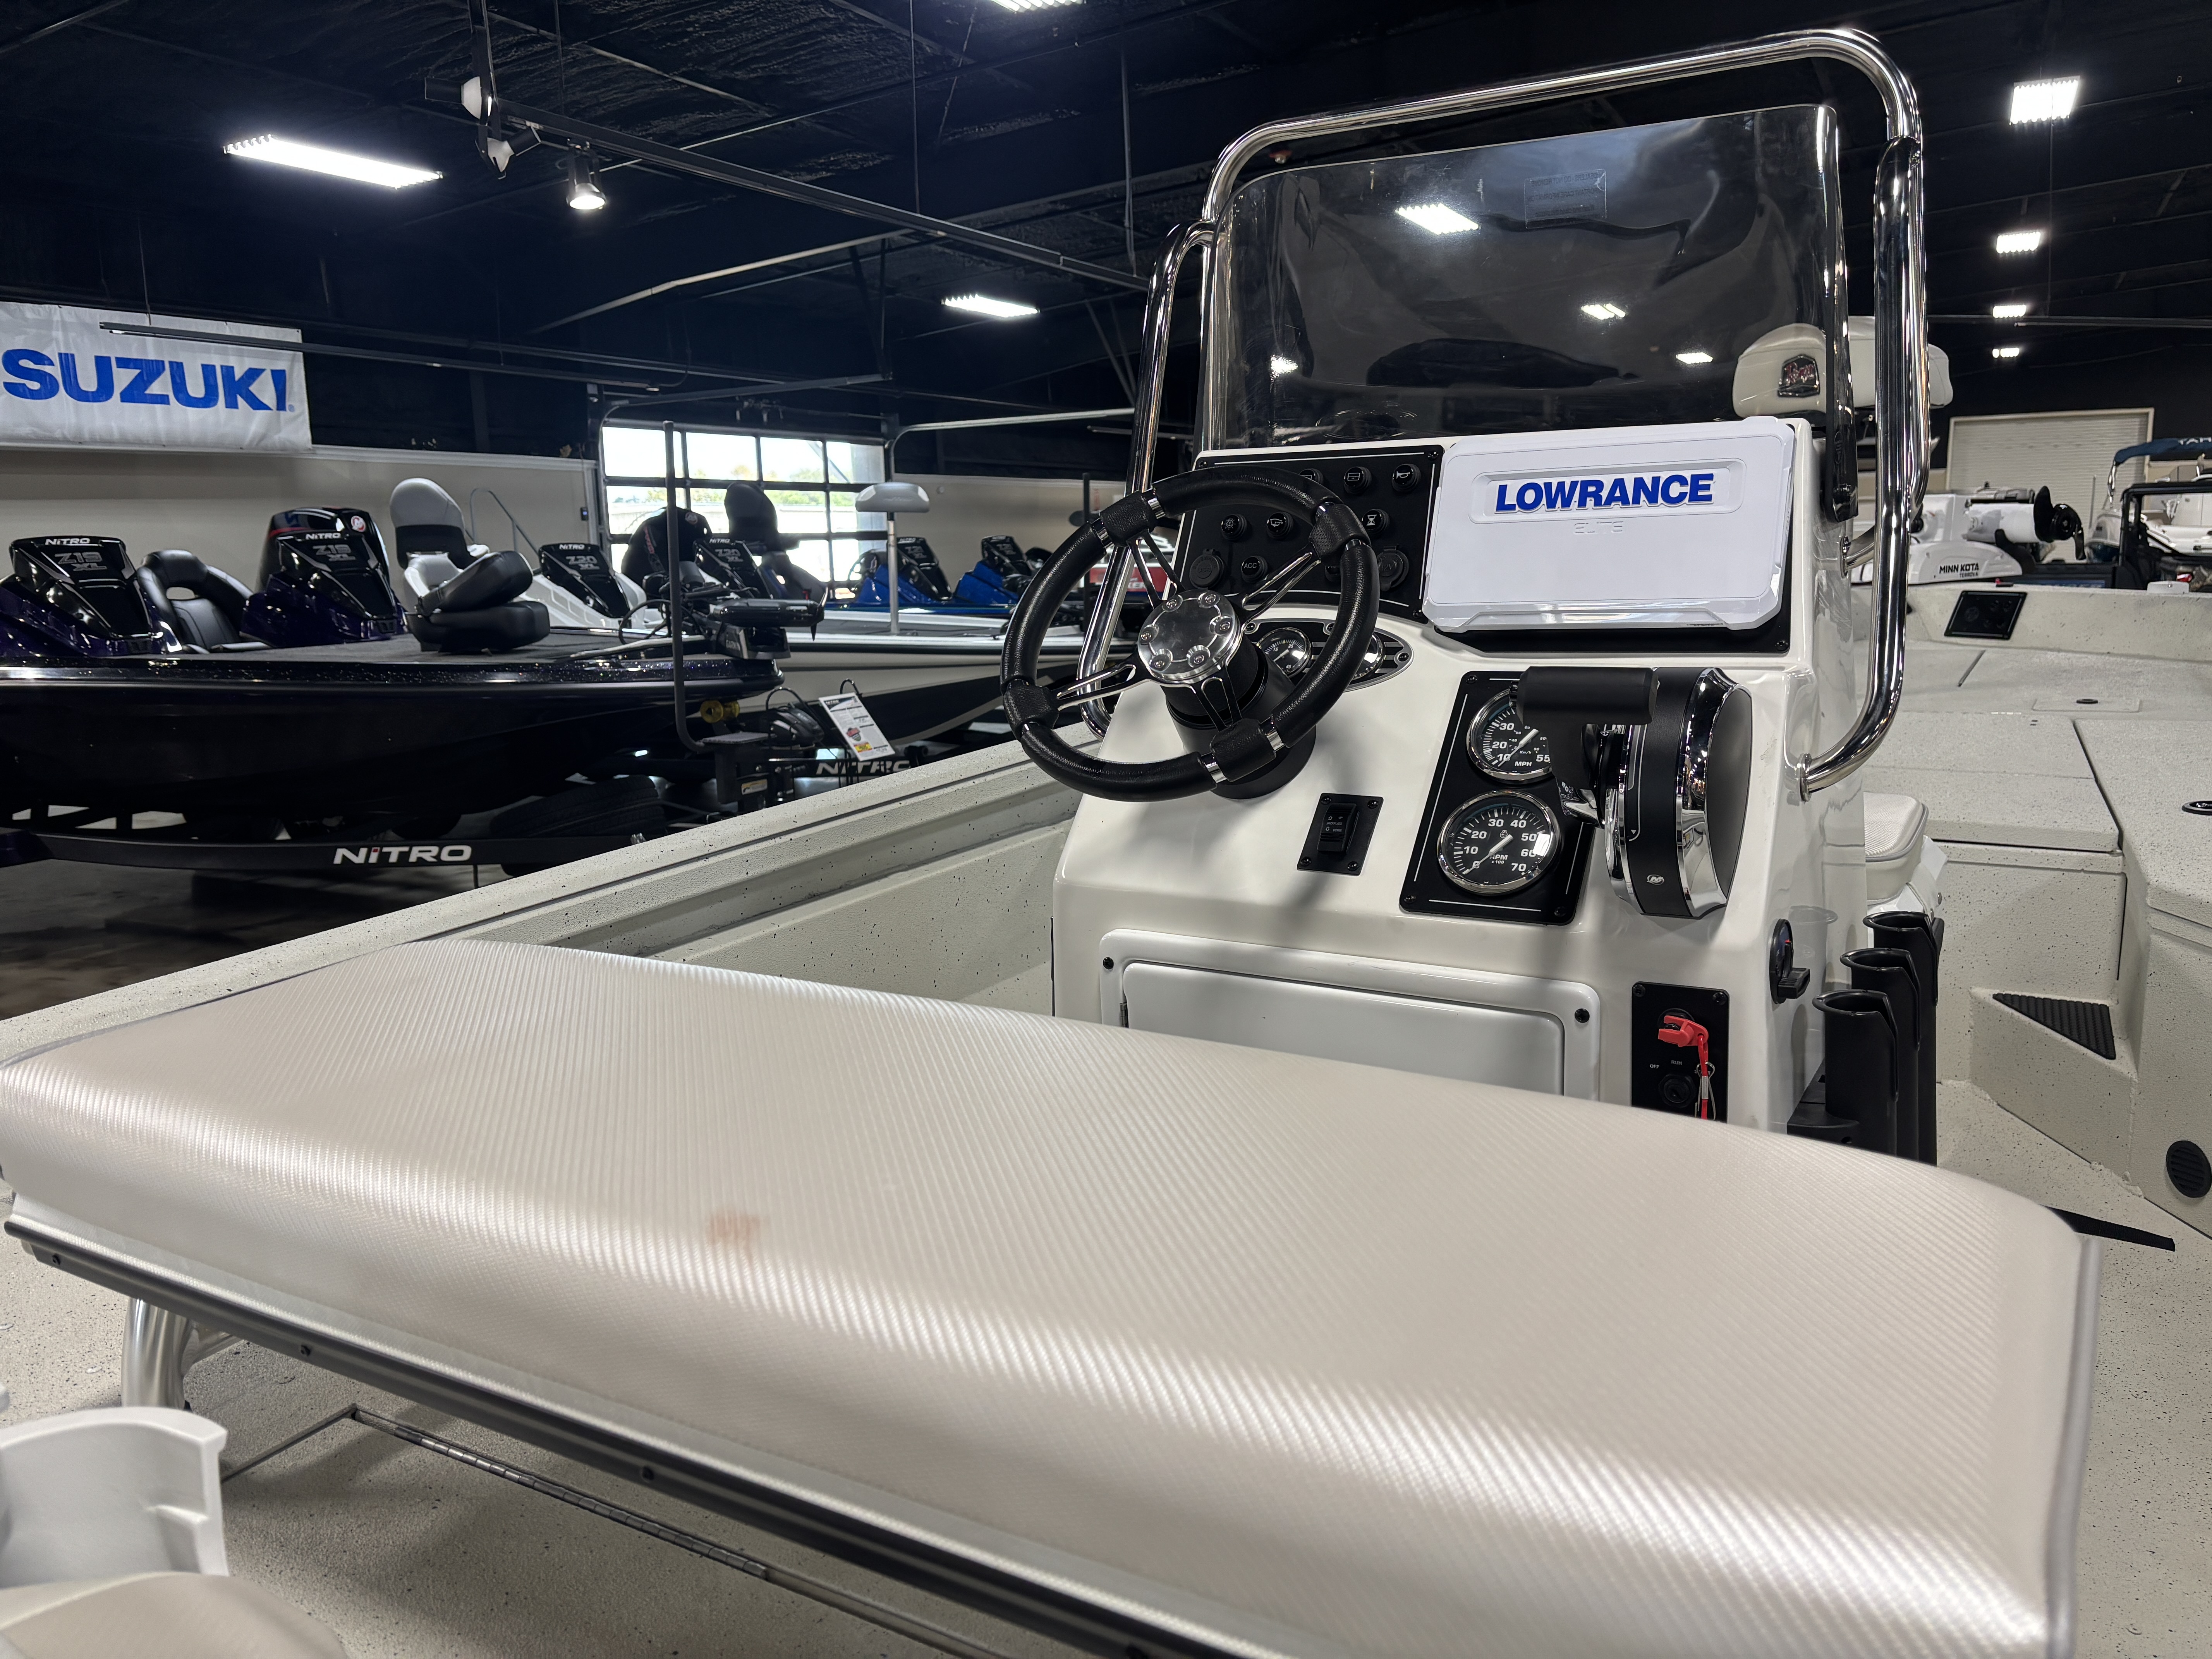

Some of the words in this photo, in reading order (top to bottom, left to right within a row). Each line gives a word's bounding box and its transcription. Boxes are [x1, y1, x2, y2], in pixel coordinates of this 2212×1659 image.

[2, 349, 287, 411] SUZUKI
[1495, 473, 1714, 513] LOWRANCE
[55, 551, 102, 564] Z19
[71, 563, 107, 571] XL
[1939, 564, 1959, 574] MINN
[1960, 562, 1979, 572] KOTA
[1488, 819, 1504, 827] 30
[1510, 820, 1527, 828] 40
[1521, 833, 1537, 841] 50
[1464, 846, 1479, 854] 10
[1521, 849, 1537, 857] 60
[1472, 861, 1480, 869] 0
[1511, 863, 1527, 872] 70
